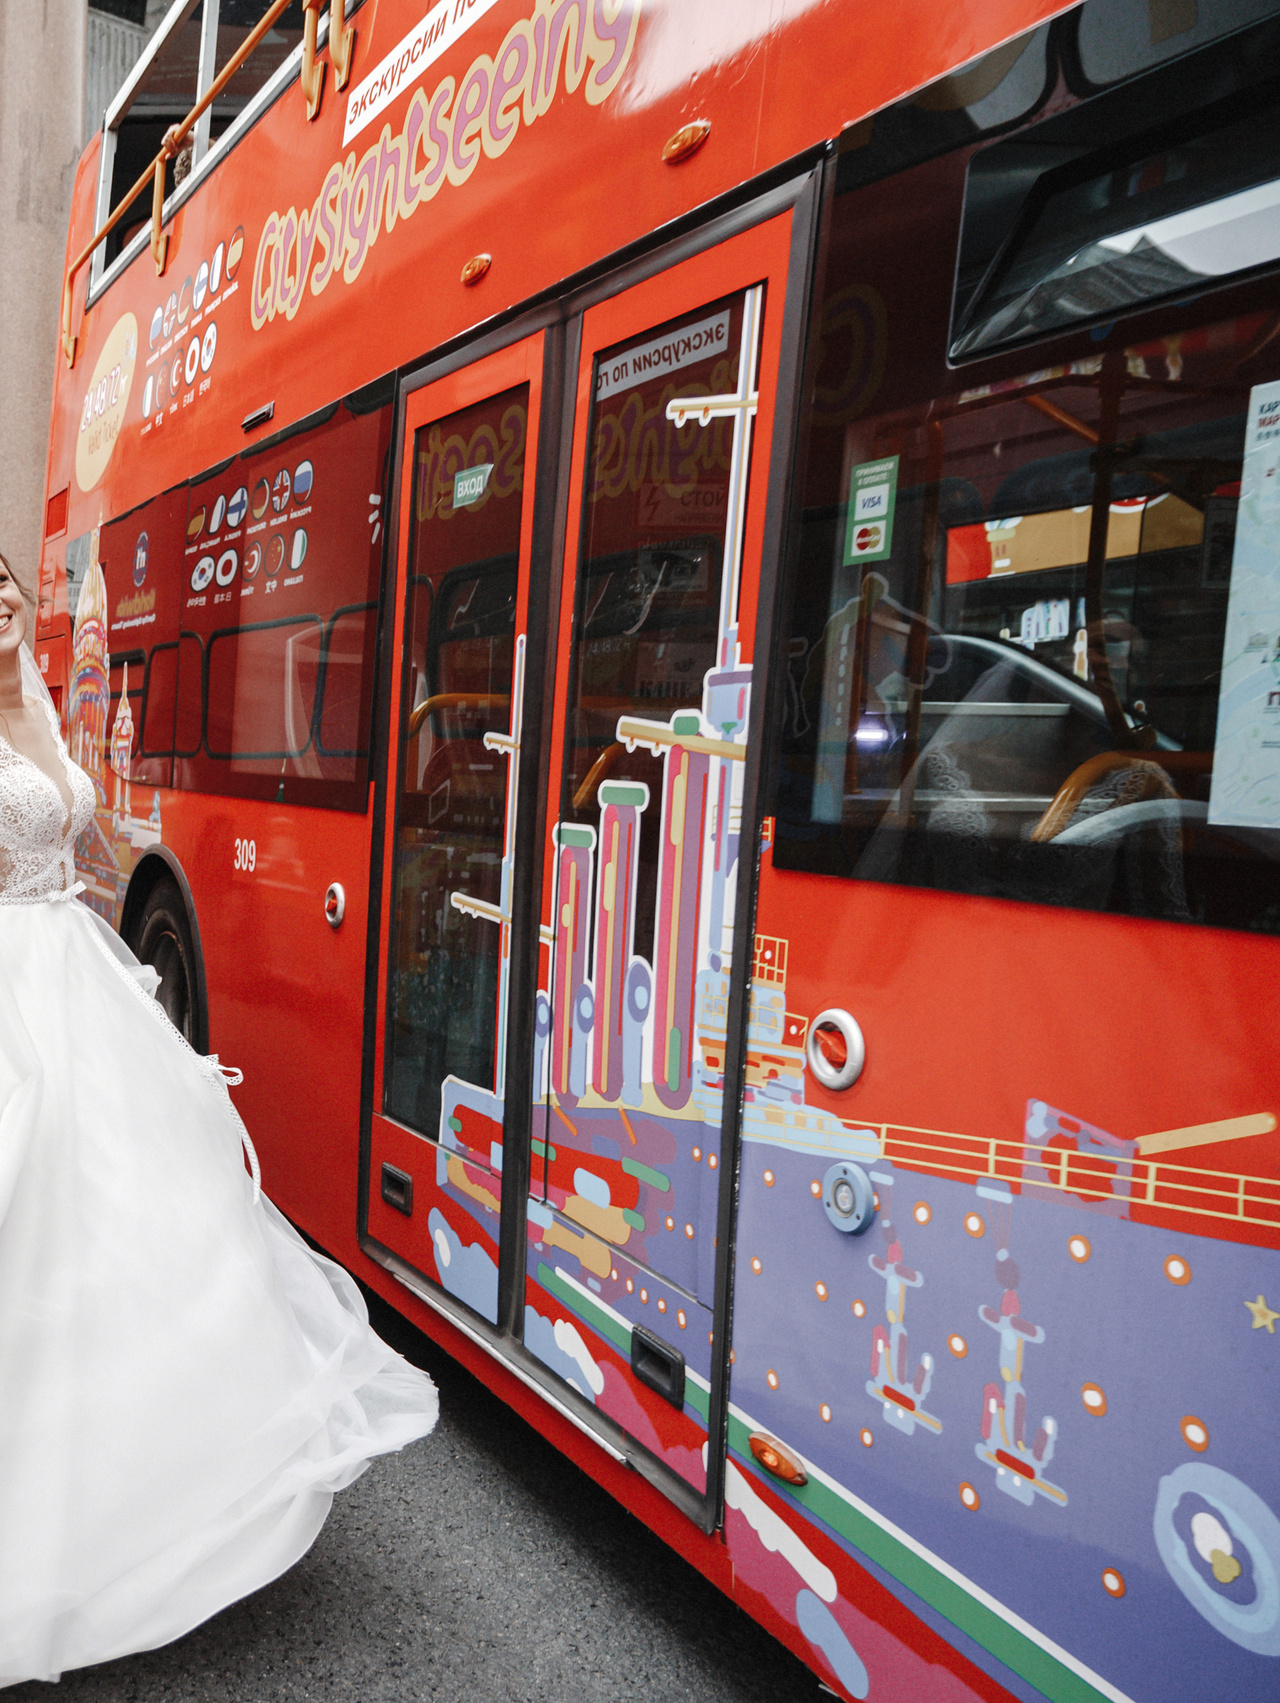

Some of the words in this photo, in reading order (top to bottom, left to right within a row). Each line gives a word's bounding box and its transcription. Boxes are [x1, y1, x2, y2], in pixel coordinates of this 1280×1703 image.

[457, 475, 484, 498] ВХОД
[862, 495, 882, 509] VISA
[234, 837, 256, 872] 309
